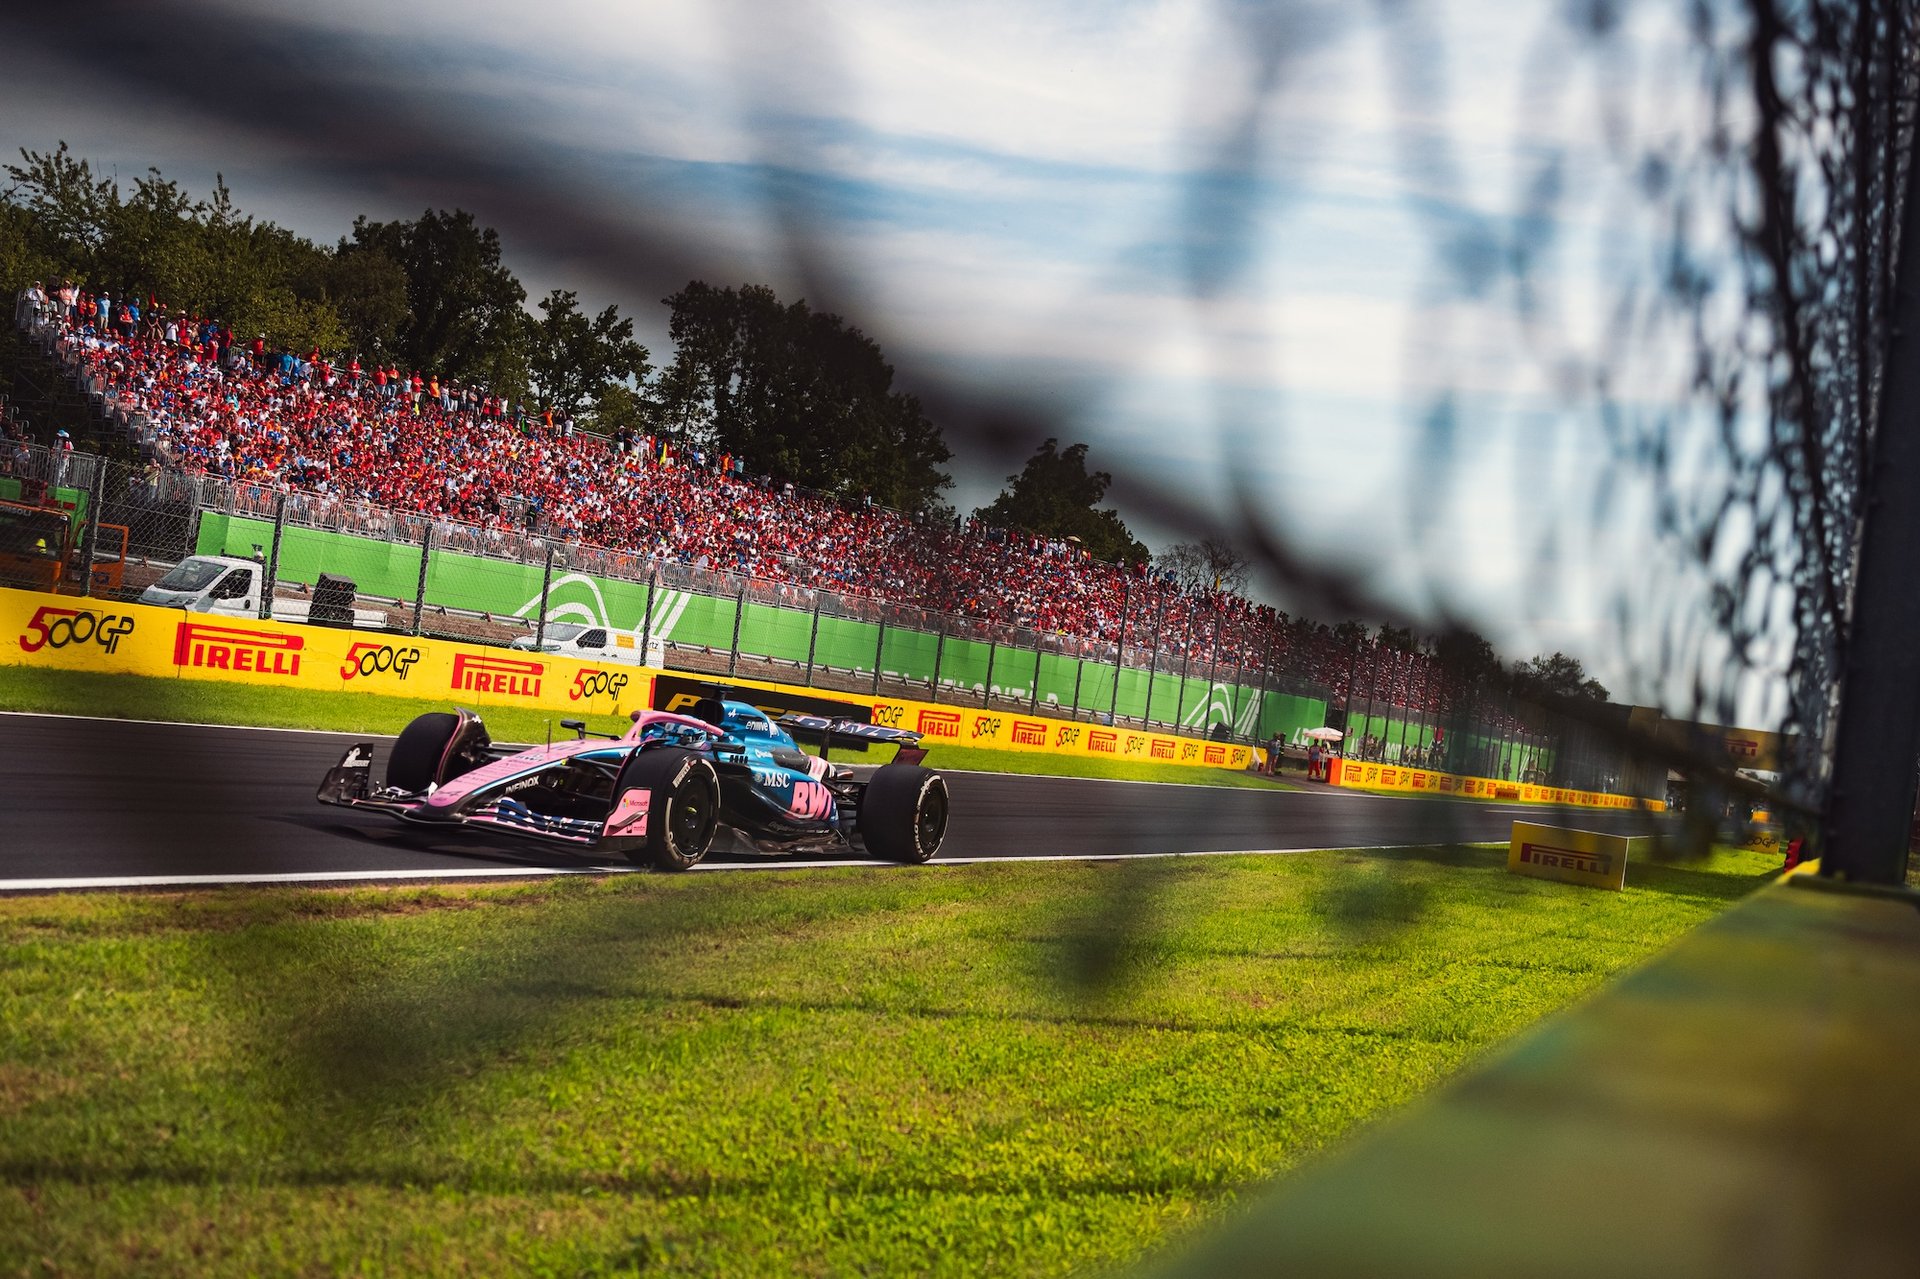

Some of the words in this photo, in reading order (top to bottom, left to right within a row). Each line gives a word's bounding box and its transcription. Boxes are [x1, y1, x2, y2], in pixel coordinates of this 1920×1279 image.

[173, 621, 304, 676] PIRELLI
[451, 653, 544, 697] PIRELLI
[917, 709, 961, 738] PIRELLI
[1012, 720, 1047, 746] PIRELLI
[1088, 730, 1117, 752] PIRELLI
[1151, 739, 1176, 759] PIRELLI
[1204, 746, 1226, 764] PIRELLI
[763, 771, 790, 788] MSC
[1520, 842, 1613, 875] PIRELLI
